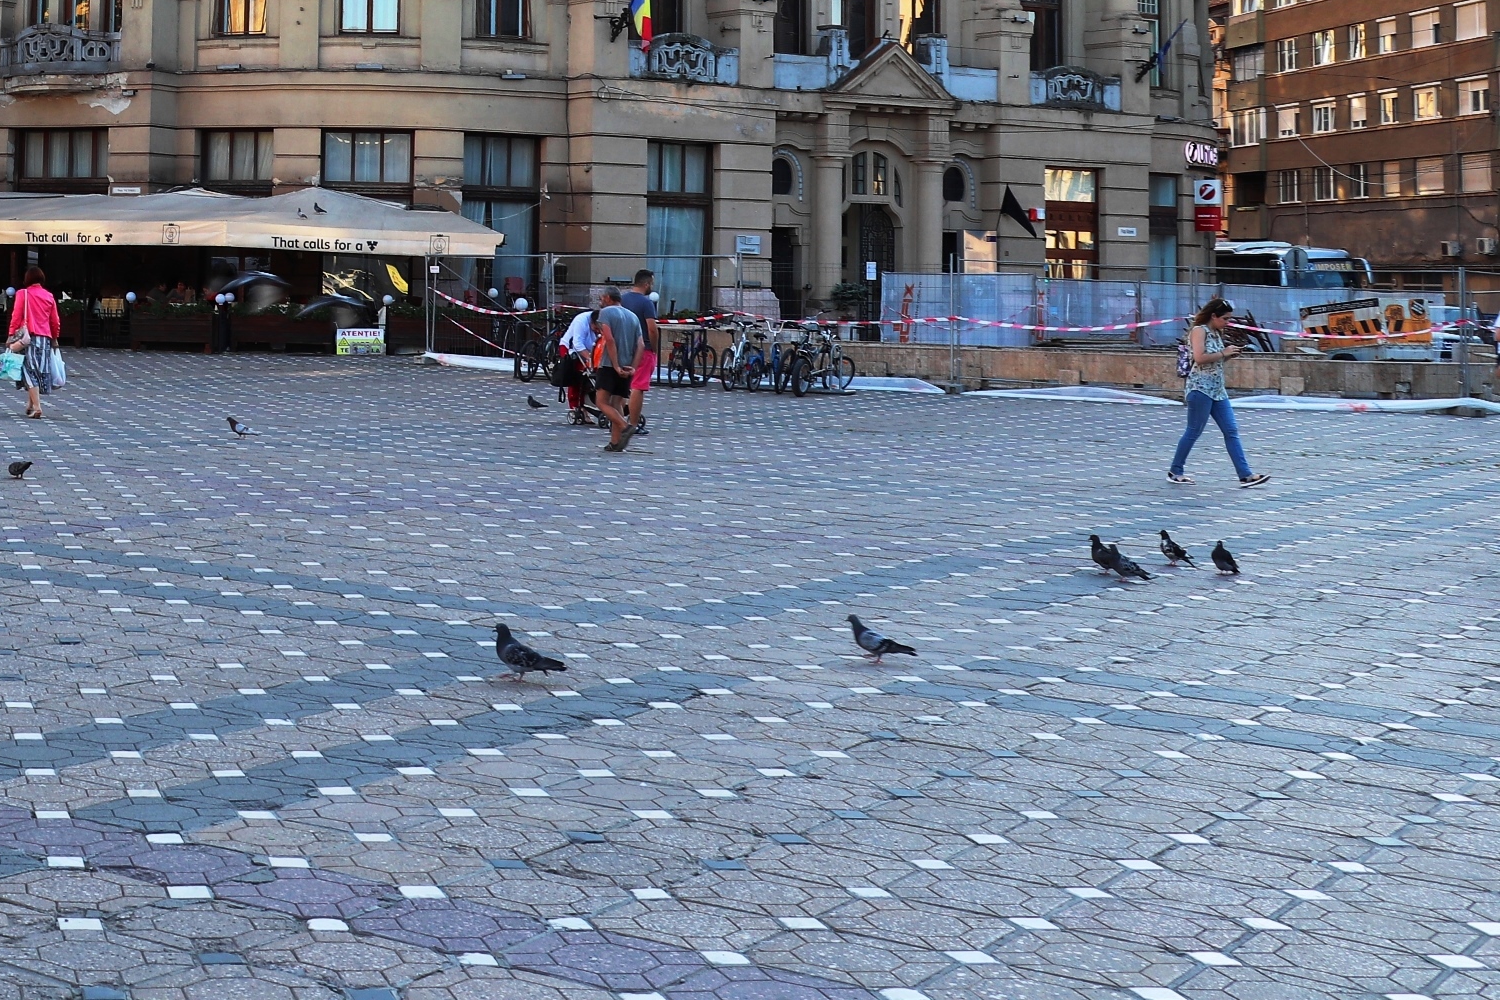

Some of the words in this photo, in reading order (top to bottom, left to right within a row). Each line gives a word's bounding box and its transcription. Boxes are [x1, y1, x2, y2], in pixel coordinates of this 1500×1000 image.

[25, 232, 49, 243] That
[77, 232, 92, 243] for
[271, 236, 300, 249] That
[303, 238, 331, 250] calls
[334, 239, 351, 251] for
[355, 242, 363, 251] a
